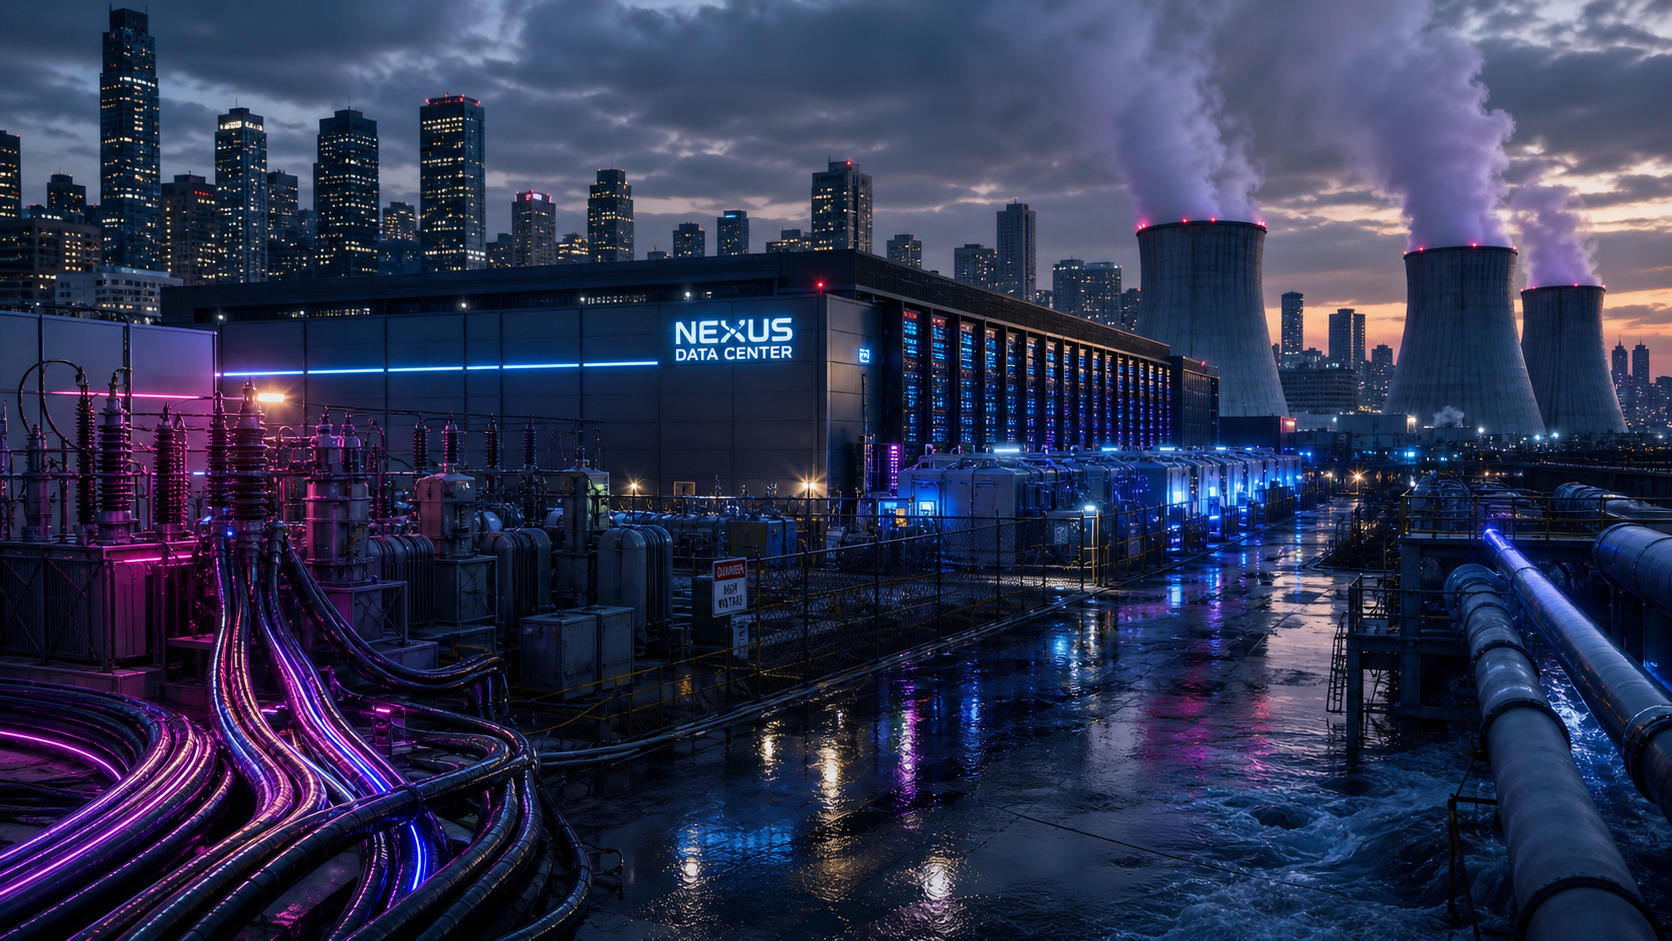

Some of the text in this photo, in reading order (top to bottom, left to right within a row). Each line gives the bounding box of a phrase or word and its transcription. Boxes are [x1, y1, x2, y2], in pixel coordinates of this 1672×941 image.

[675, 318, 793, 345] NEXUS
[675, 346, 793, 361] DATA CENTER
